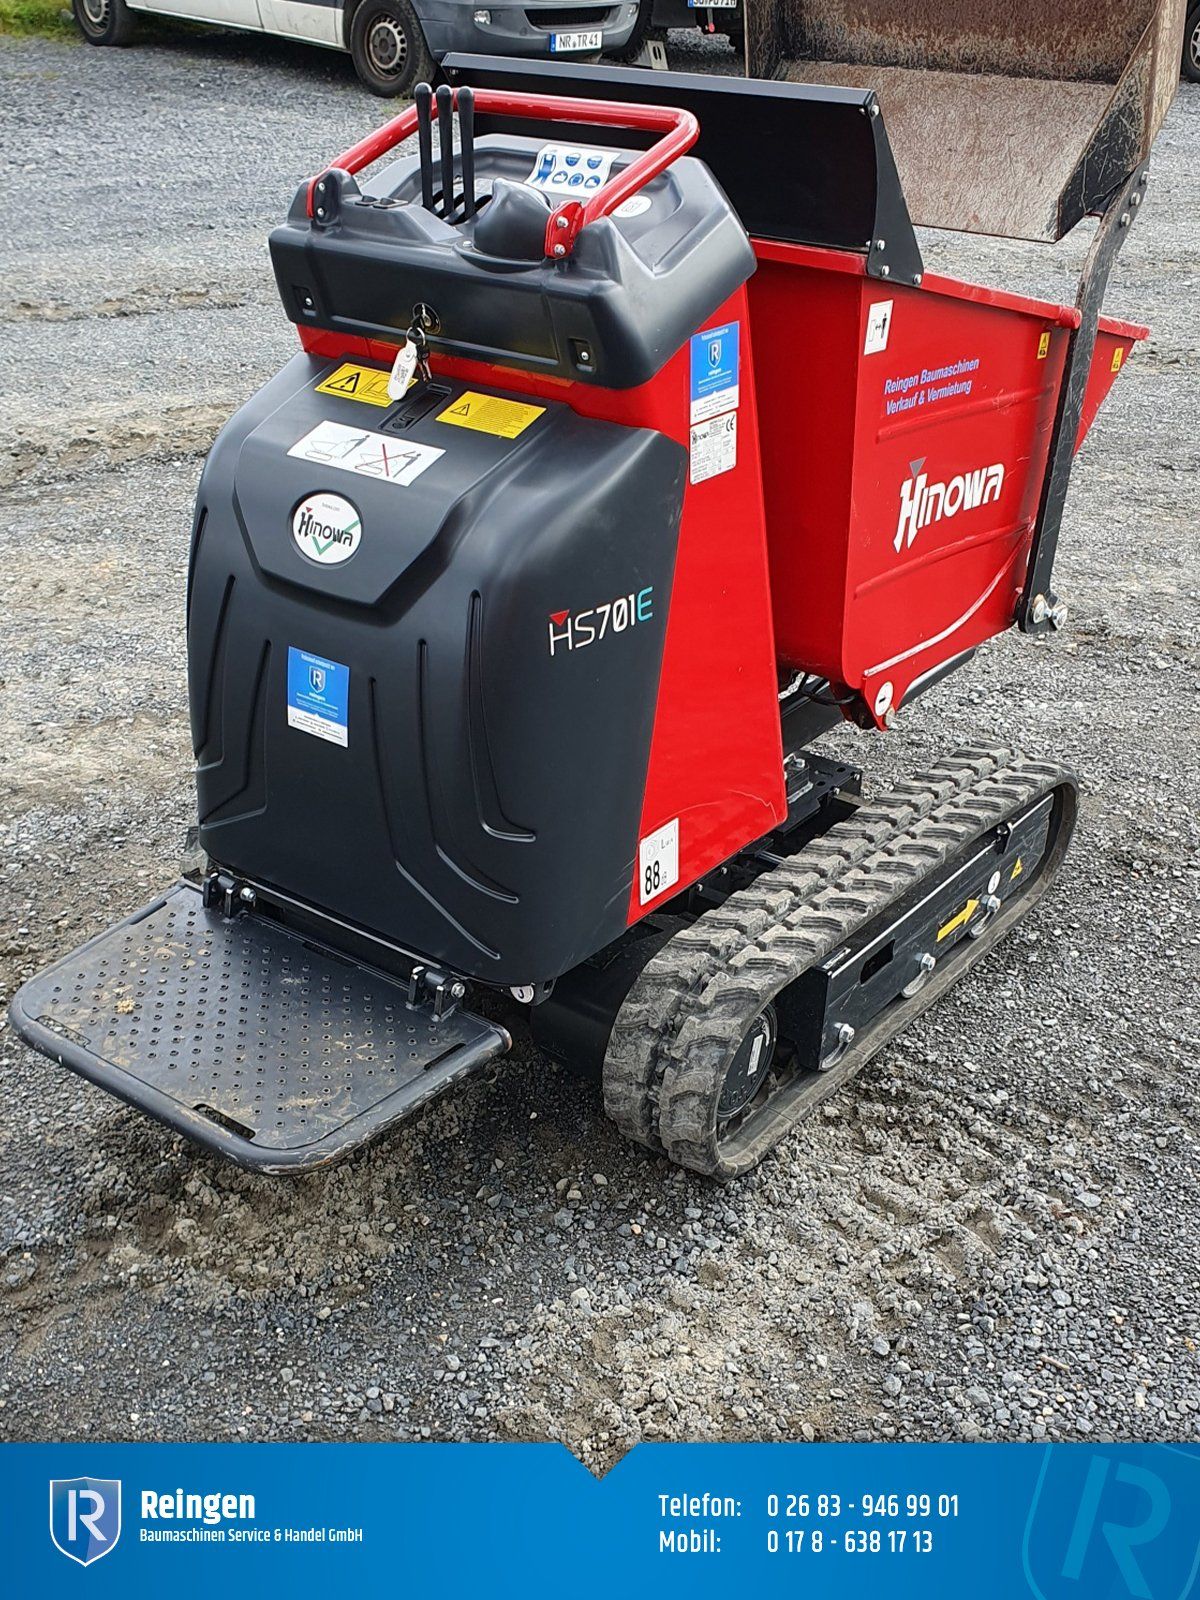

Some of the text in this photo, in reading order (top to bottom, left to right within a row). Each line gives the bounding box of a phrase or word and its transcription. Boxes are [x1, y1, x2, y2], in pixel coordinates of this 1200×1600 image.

[559, 33, 598, 48] NR TR 41
[884, 358, 980, 395] Reingen Baumaschinen
[886, 380, 973, 415] Verkauf & Vermietung
[548, 586, 654, 657] HS701E
[644, 860, 661, 896] 88
